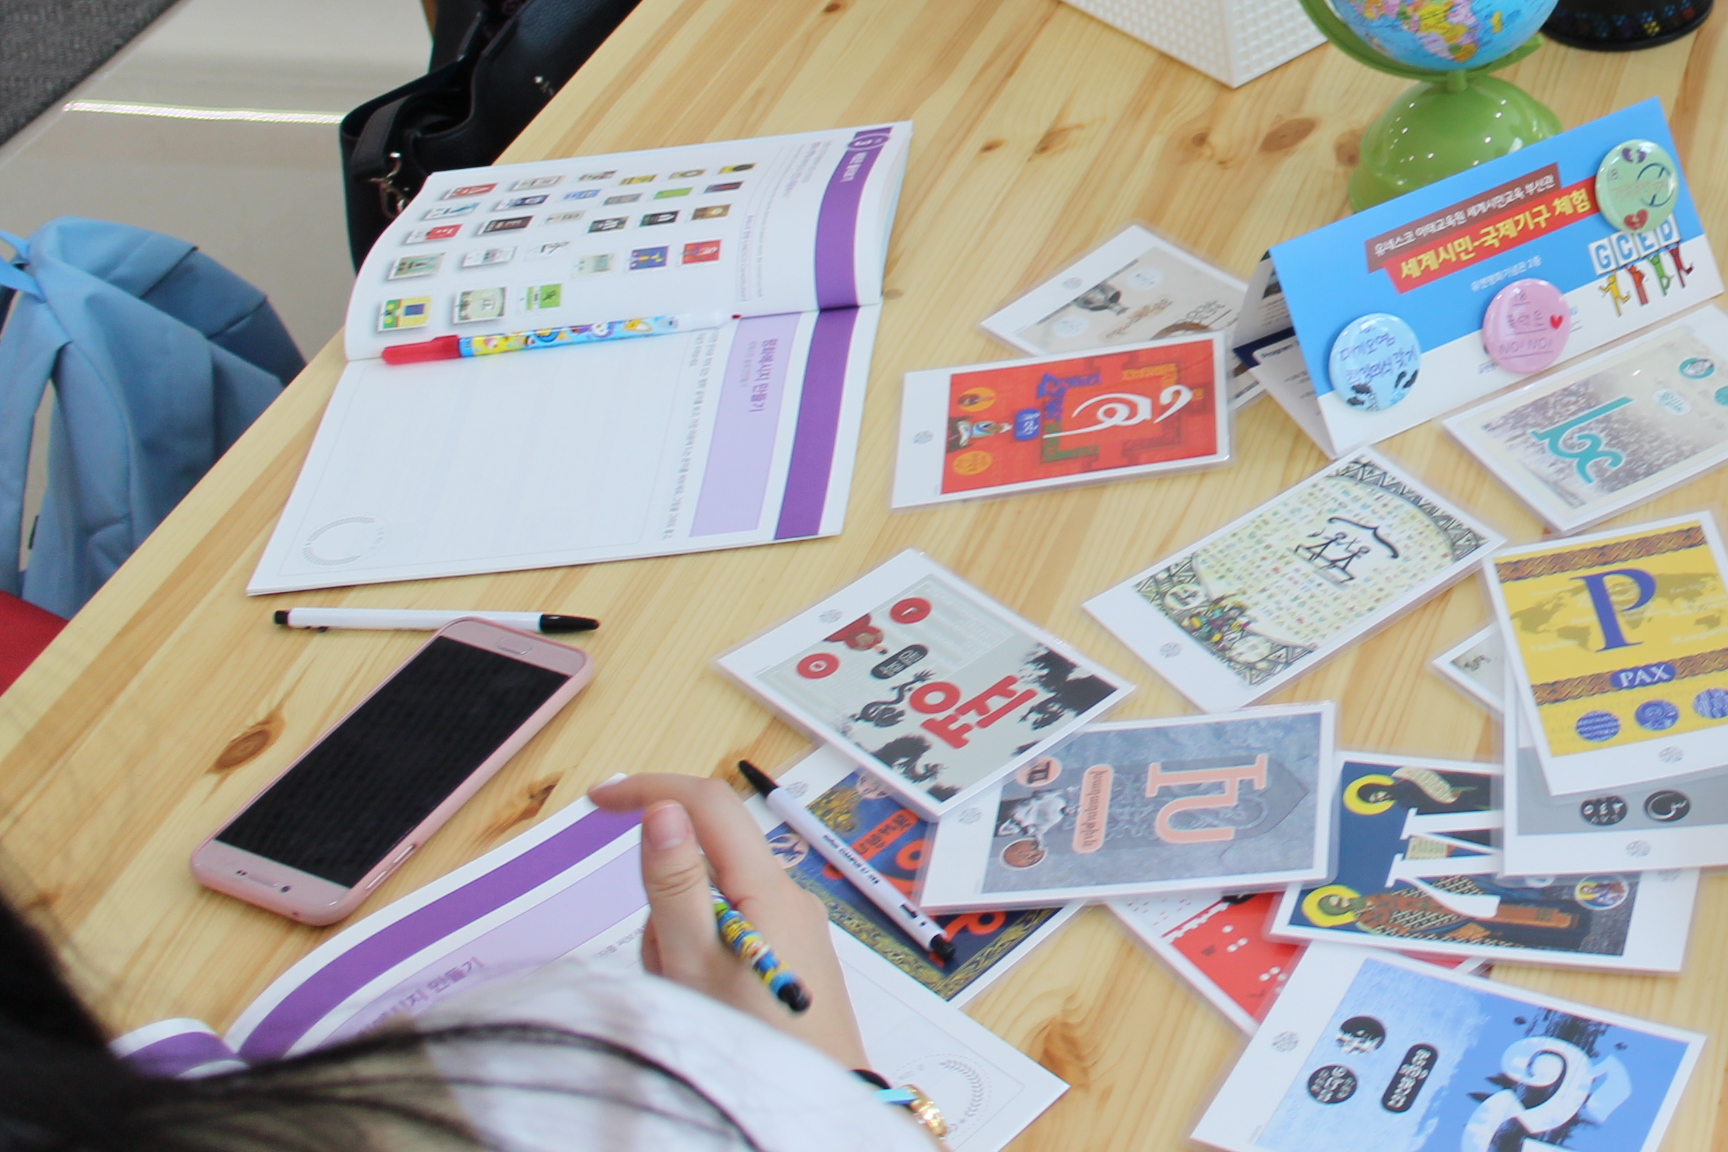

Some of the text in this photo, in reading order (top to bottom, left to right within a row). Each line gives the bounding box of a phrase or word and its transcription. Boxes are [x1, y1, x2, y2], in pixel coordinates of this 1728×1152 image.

[1374, 231, 1414, 258] 유네스코
[1415, 209, 1467, 238] 아태교육원
[1467, 188, 1525, 219] 세계시민교육
[1553, 187, 1592, 215] 체험
[1594, 219, 1674, 269] GCED
[1568, 568, 1657, 653] P
[1617, 664, 1671, 688] PAX
[425, 954, 485, 996] 만들기
